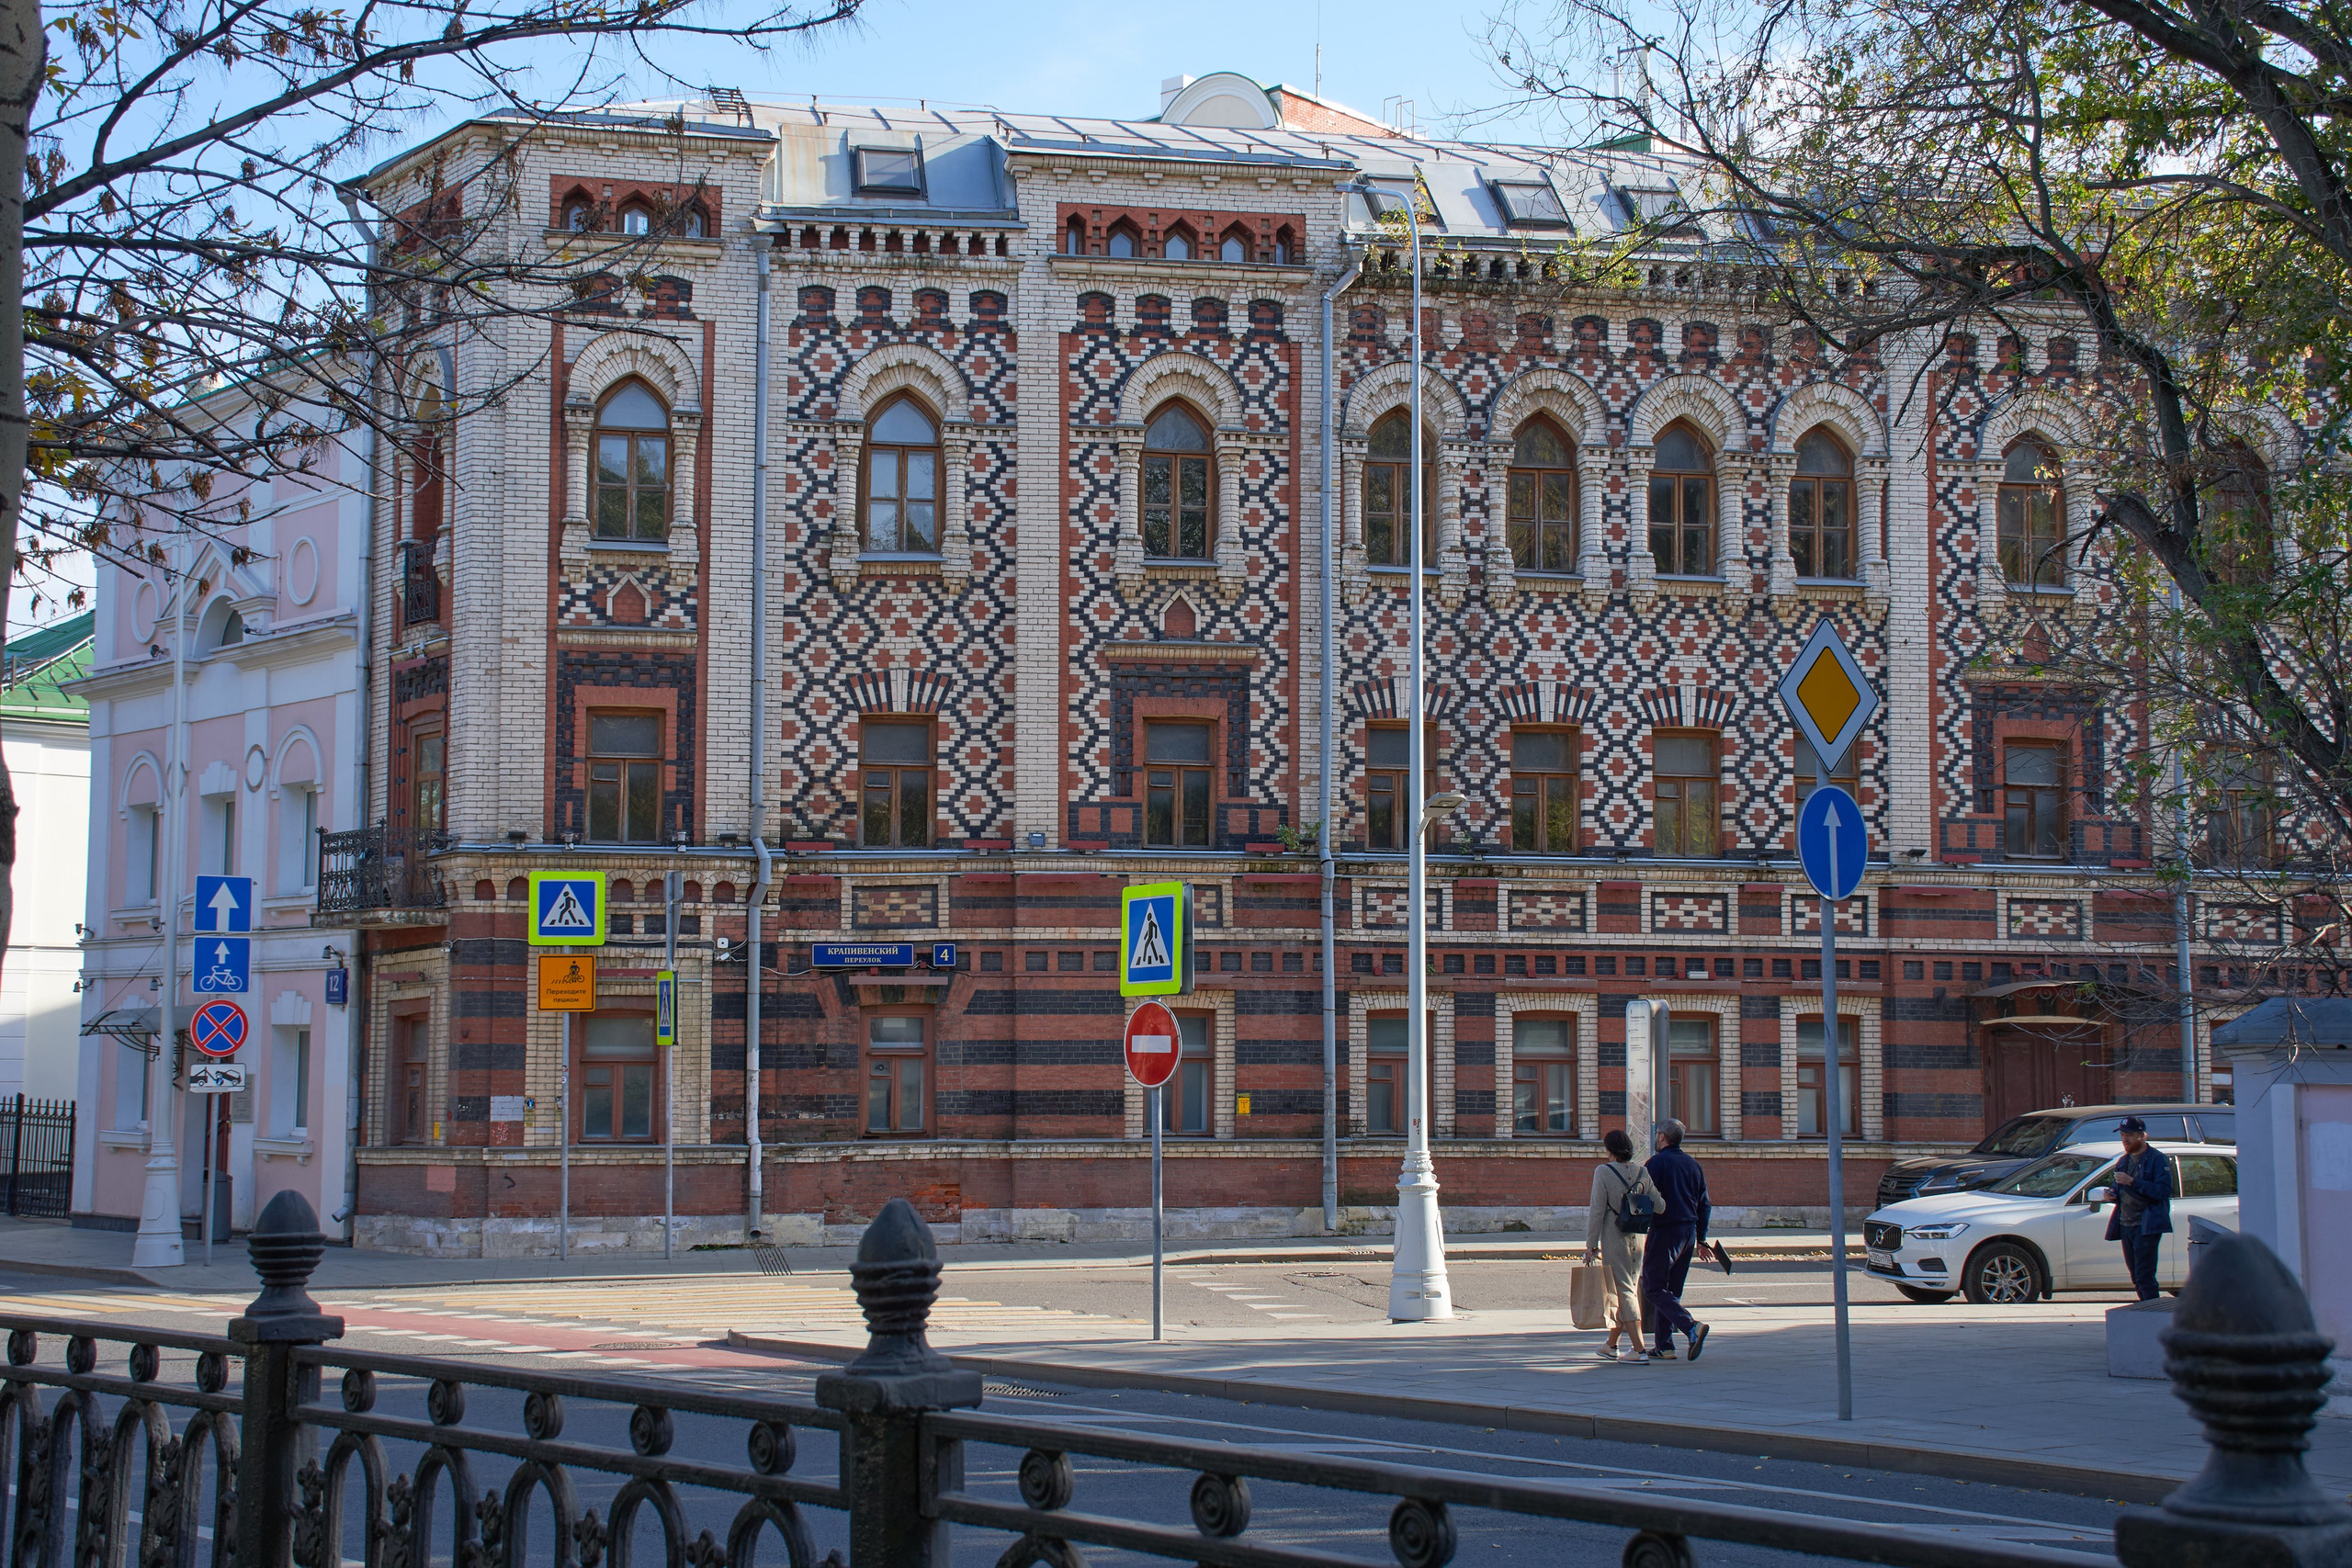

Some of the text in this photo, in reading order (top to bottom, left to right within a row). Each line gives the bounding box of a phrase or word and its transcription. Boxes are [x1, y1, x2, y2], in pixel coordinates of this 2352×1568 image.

[828, 946, 899, 955] КРАПИВЕНСКИЙ
[940, 948, 949, 961] 4
[329, 975, 339, 992] 12
